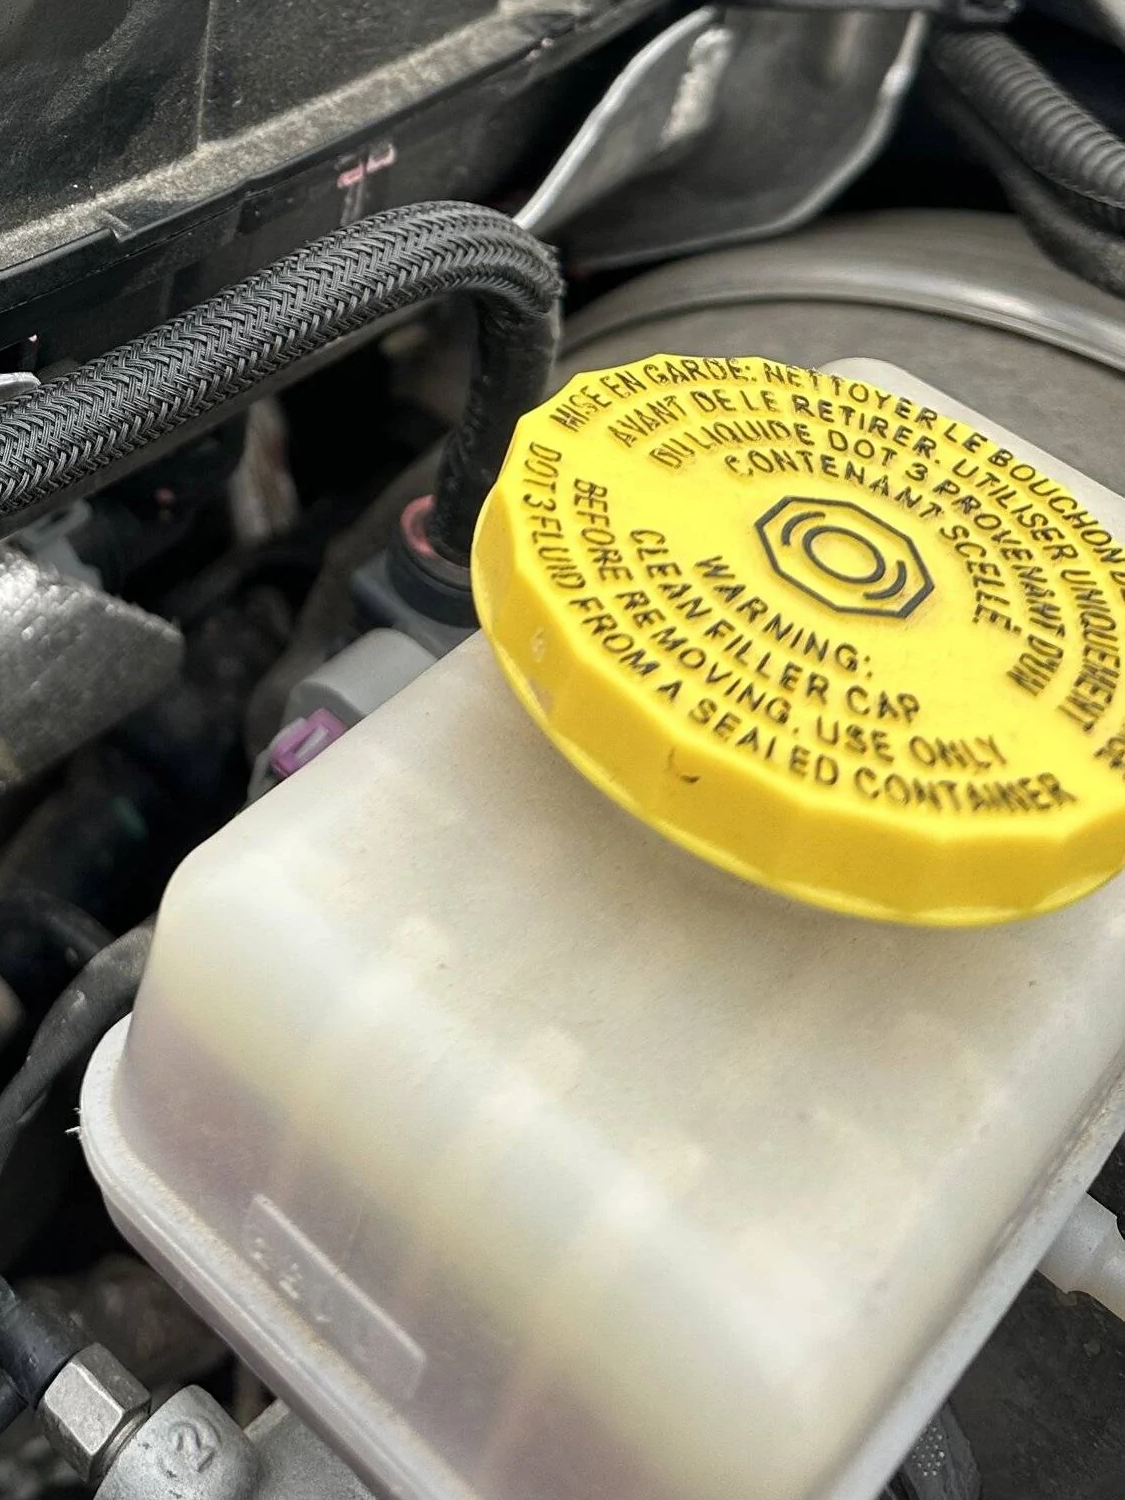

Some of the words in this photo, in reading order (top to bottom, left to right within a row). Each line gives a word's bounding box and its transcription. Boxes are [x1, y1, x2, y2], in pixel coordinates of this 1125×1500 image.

[523, 441, 562, 494] DOT
[523, 493, 557, 512] 3
[549, 385, 612, 432] MISE
[600, 370, 647, 399] EN
[643, 357, 757, 385] GARDE:
[763, 362, 938, 430] NETTOYER
[943, 422, 989, 454] LE
[987, 448, 1125, 564] BOUCHON
[724, 449, 945, 518] CONTENANT
[530, 515, 586, 589] FLUID
[607, 395, 687, 448] AVANT
[690, 389, 737, 413] DE
[740, 390, 779, 412] LE
[791, 394, 941, 465] RETIRER.
[952, 458, 1079, 561] UTILISER
[1057, 569, 1121, 732] UNIQUEMENT
[649, 438, 695, 470] DU
[684, 420, 815, 450] LIQUIDE
[828, 429, 898, 466] DOT
[905, 462, 928, 481] 3
[932, 479, 1066, 638] PROVENANT
[568, 596, 661, 677] FROM
[573, 477, 634, 581] BEFORE
[614, 590, 800, 735] REMOVING.
[816, 715, 895, 764] USE
[908, 734, 1008, 772] ONLY
[629, 529, 713, 620] CLEAN
[703, 618, 830, 705] FILLER
[845, 685, 920, 724] CAP
[694, 555, 873, 680] WARNING:
[656, 680, 683, 702] A
[687, 698, 840, 787] SEALED
[854, 766, 1077, 812] CONTAINER
